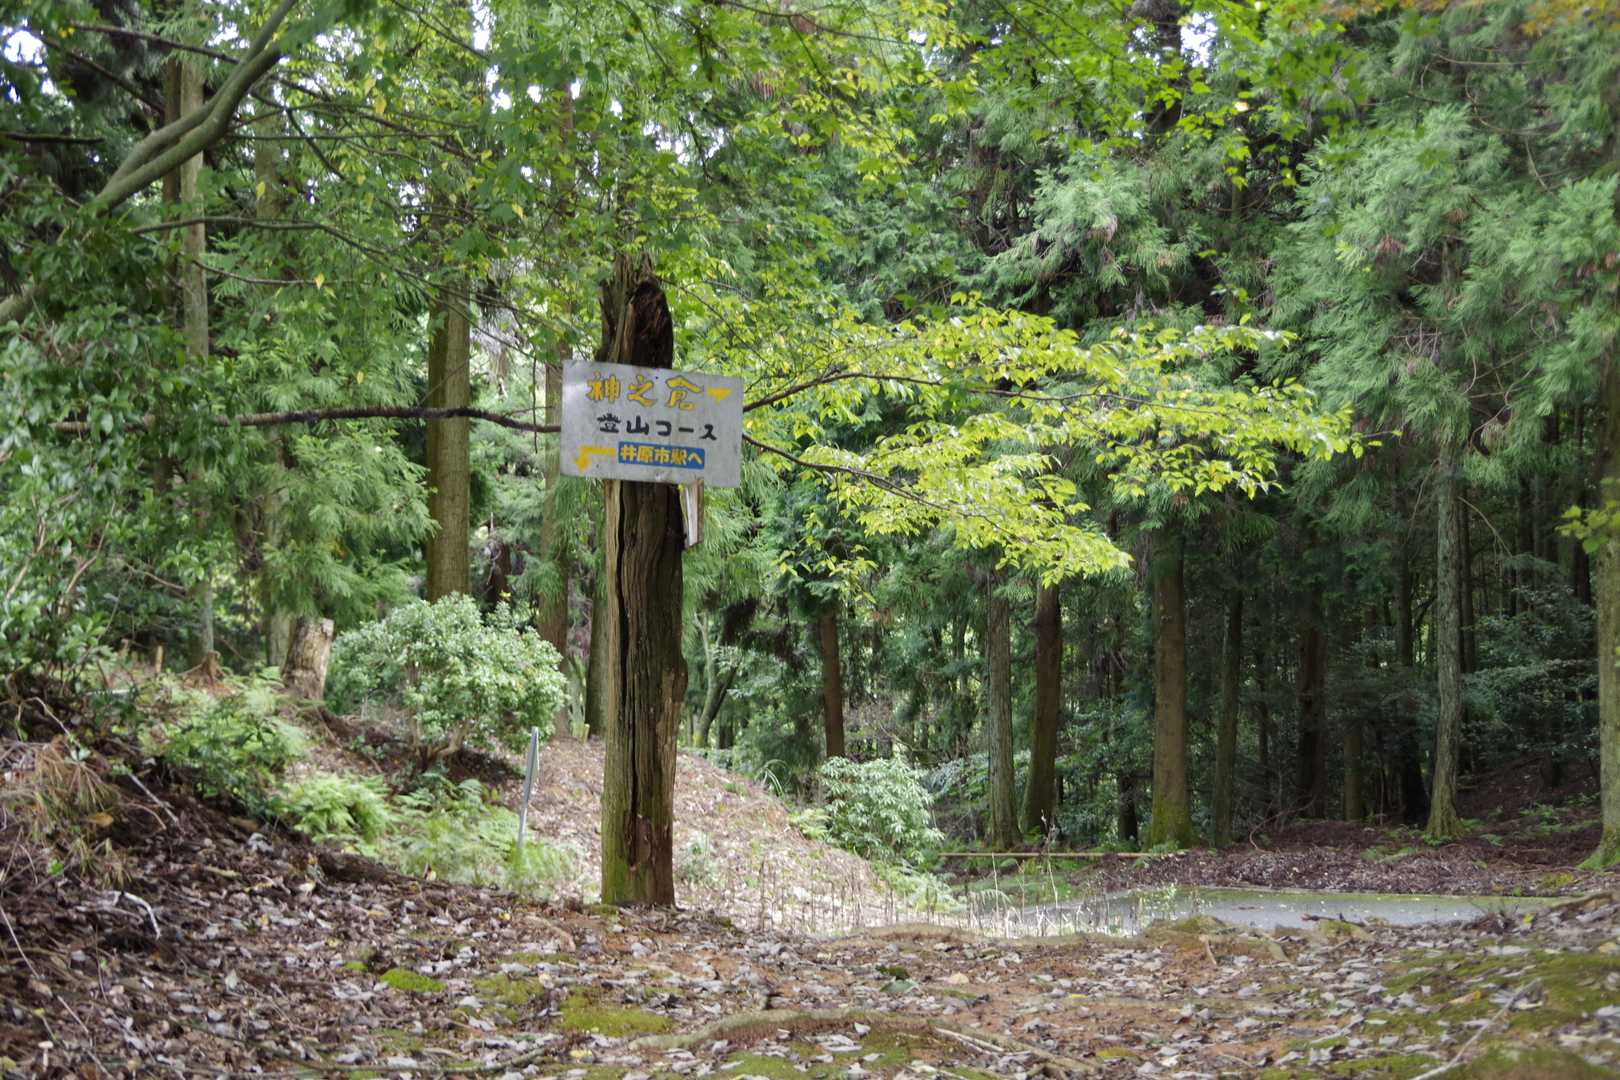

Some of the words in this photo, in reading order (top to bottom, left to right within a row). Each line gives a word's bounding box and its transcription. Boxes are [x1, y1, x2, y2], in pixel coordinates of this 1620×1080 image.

[596, 413, 717, 440] 登山コース
[620, 444, 702, 466] 井原市駅へ
